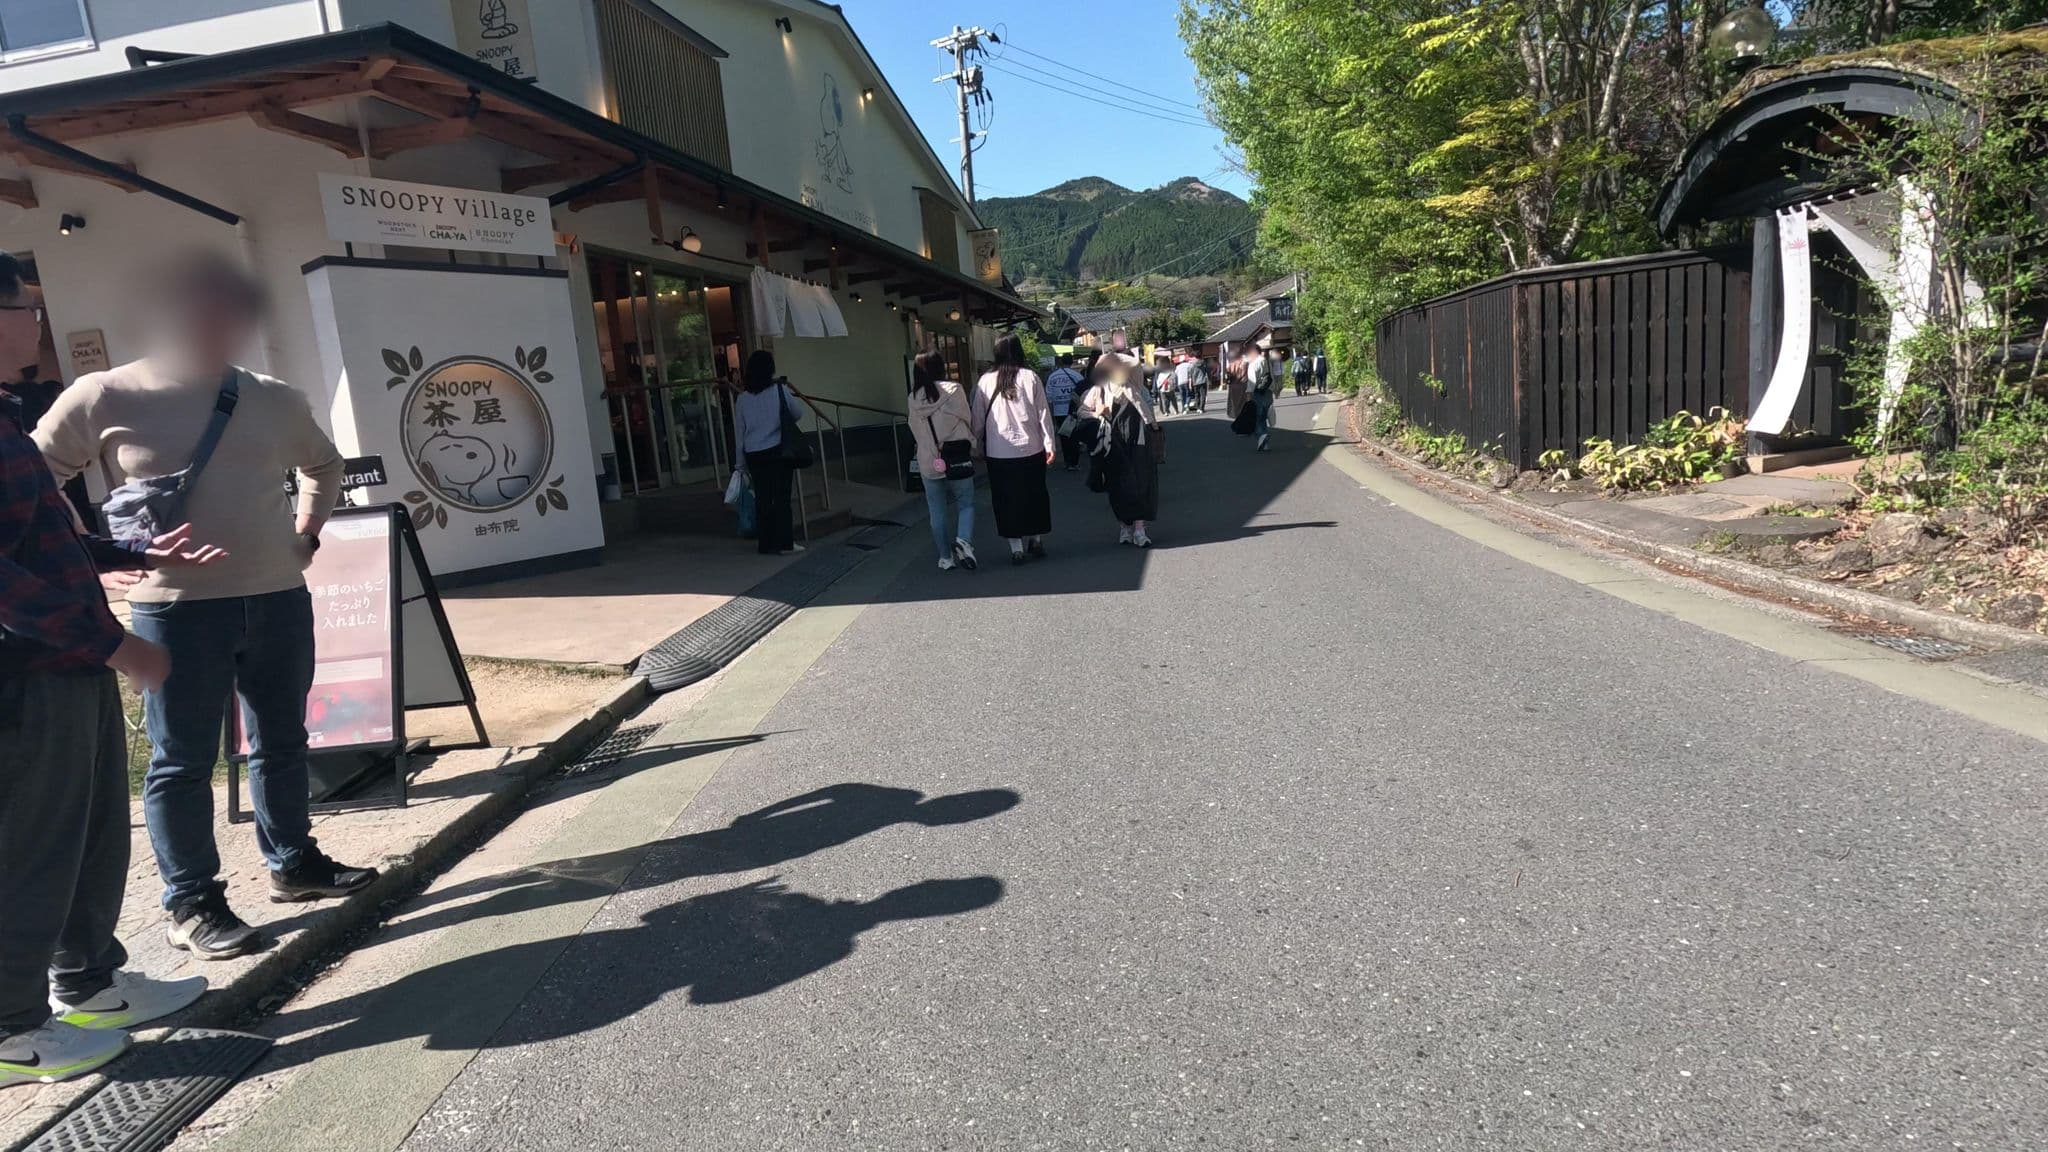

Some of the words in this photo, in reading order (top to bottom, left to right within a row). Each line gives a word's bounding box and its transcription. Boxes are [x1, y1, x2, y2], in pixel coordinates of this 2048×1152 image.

[476, 46, 513, 60] SNOOPY
[342, 186, 444, 214] SNOOPY
[454, 198, 535, 227] Village
[429, 230, 467, 241] CHA-YA
[425, 380, 493, 397] SNOOPY
[423, 398, 506, 427] 茶屋
[475, 519, 520, 536] 由布院
[313, 578, 385, 599] 季節のいちご
[328, 598, 371, 613] たっぷり
[322, 612, 377, 630] 入れました
